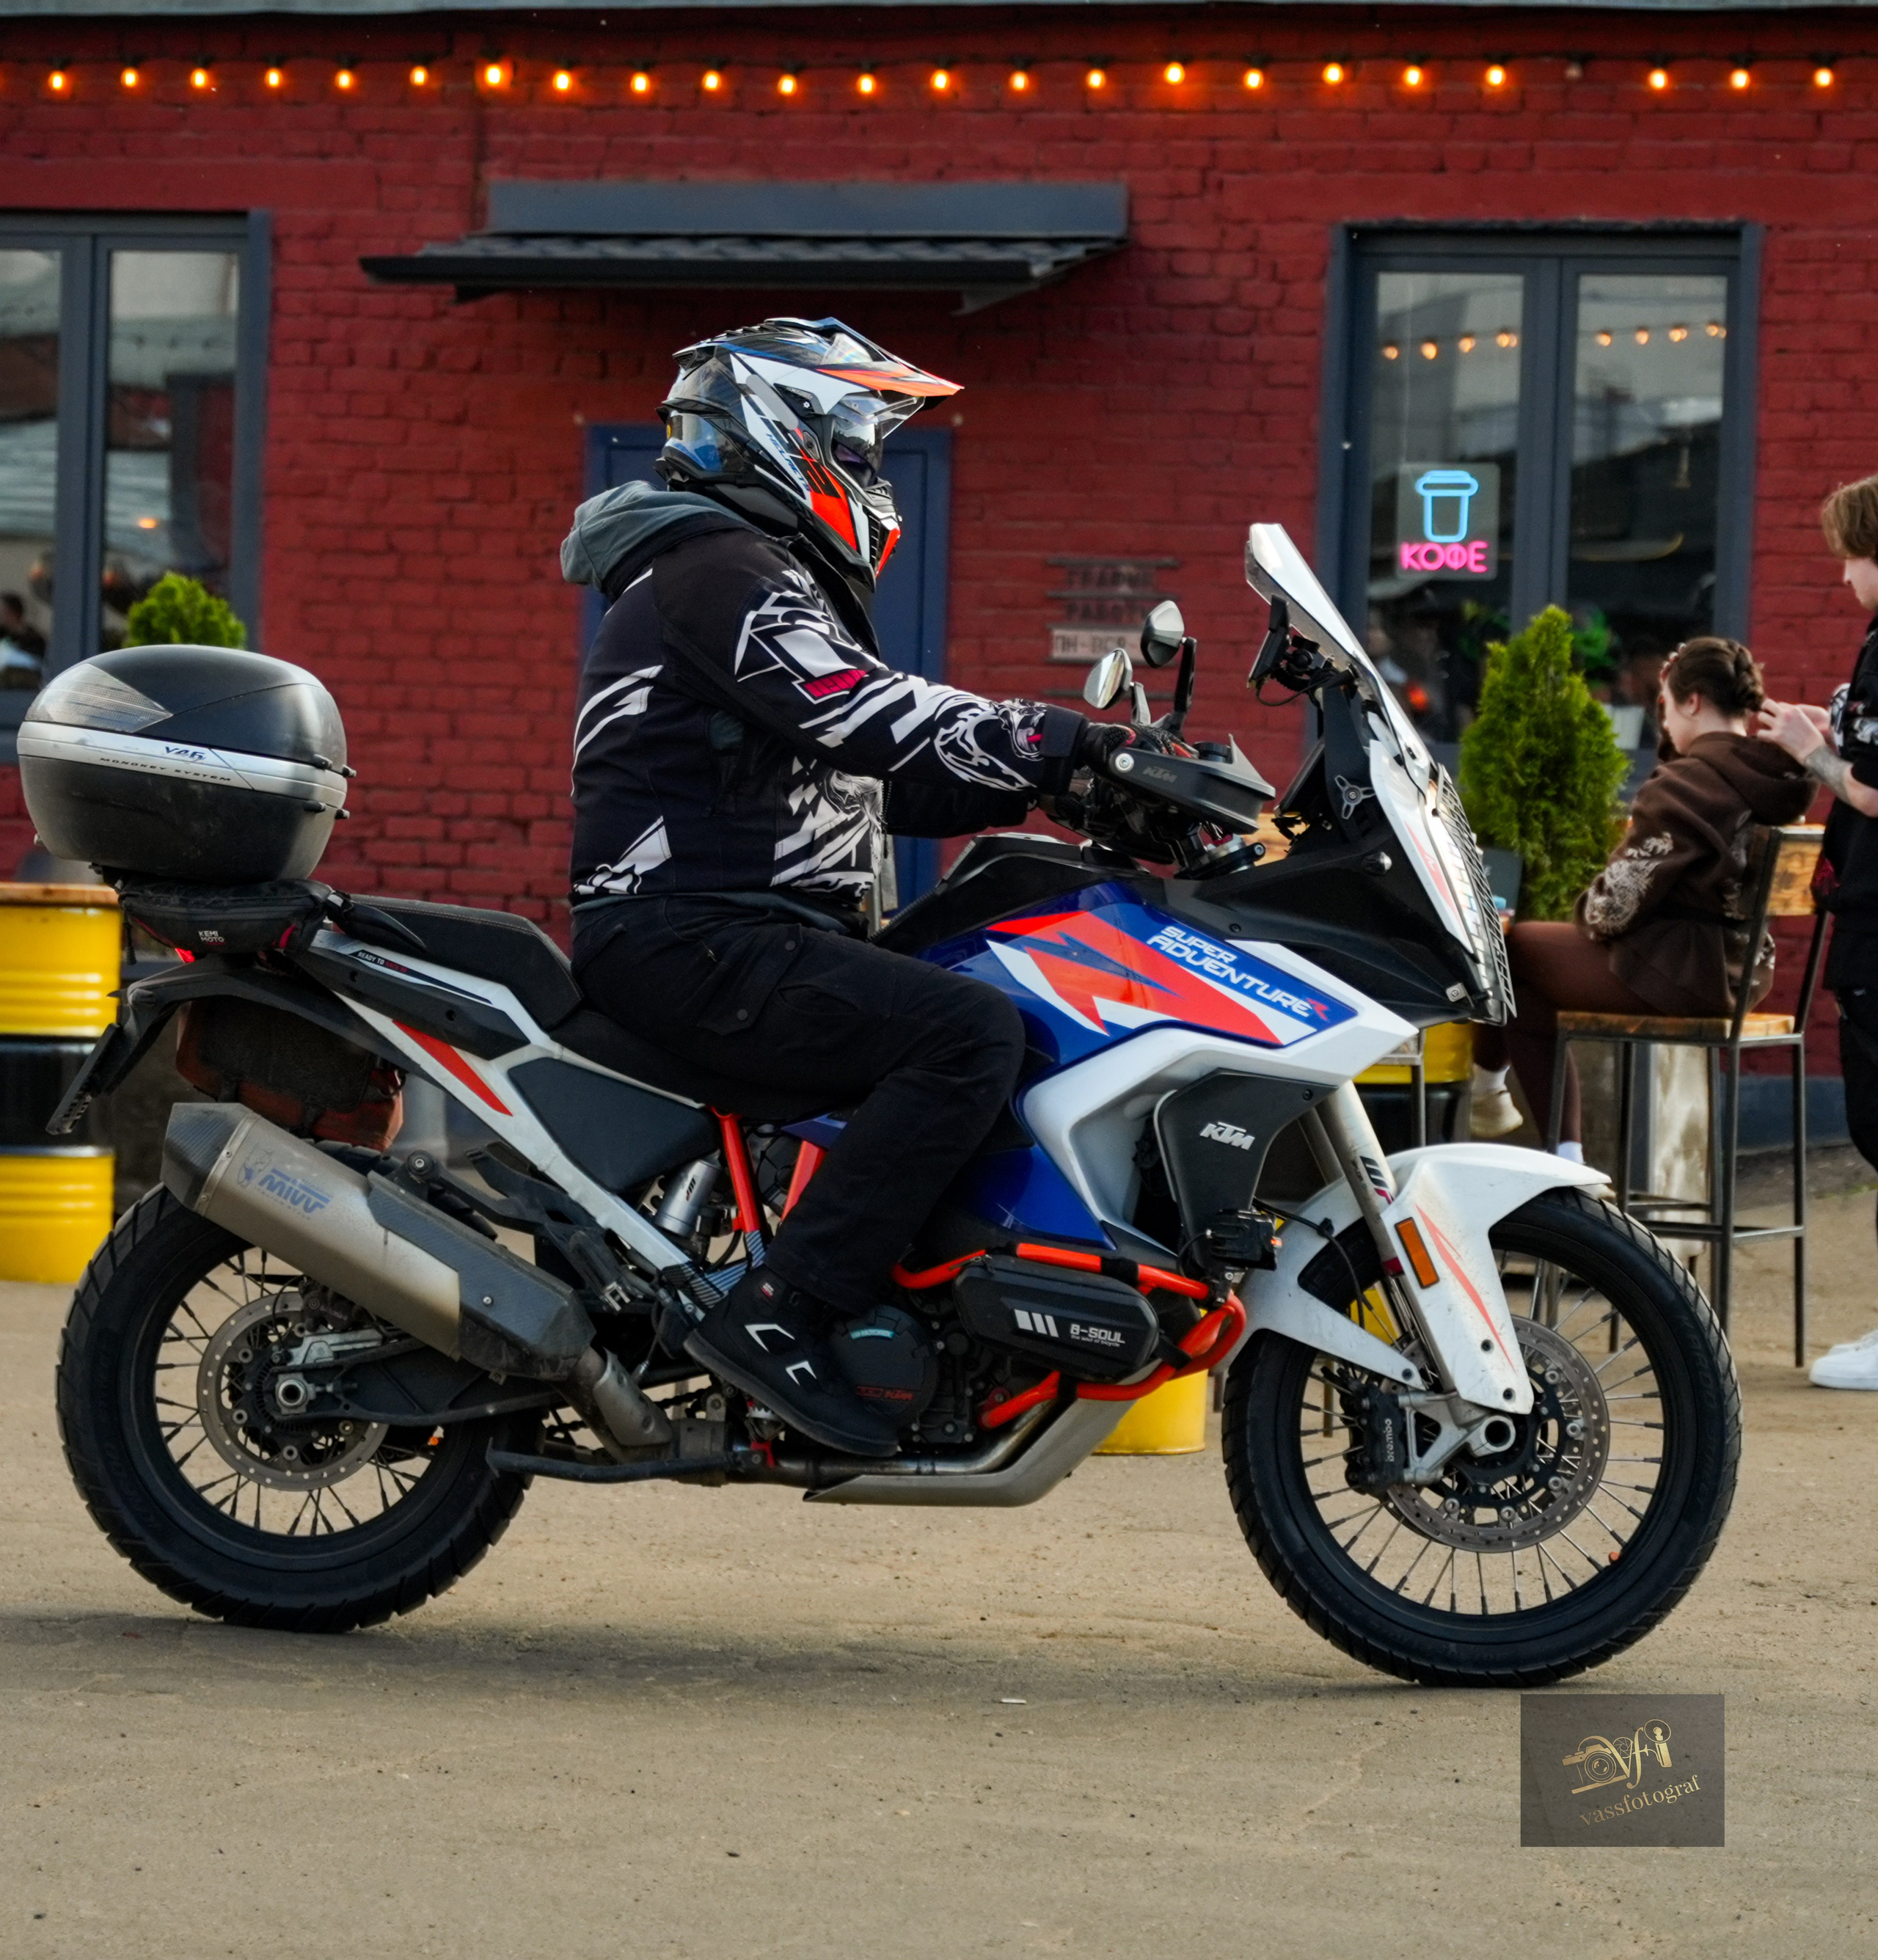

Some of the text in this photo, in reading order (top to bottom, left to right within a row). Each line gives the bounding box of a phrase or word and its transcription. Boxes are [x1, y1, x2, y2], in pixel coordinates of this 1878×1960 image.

[1400, 541, 1488, 572] КОФЕ
[99, 757, 231, 782] MONOKEY SYSTEM
[357, 951, 376, 962] READY
[1160, 926, 1238, 964] SUPER
[1146, 935, 1312, 1017] ADVENTURE
[1199, 1122, 1255, 1150] KTM
[1070, 1323, 1125, 1344] B-SOUL
[1383, 1418, 1395, 1462] brembo
